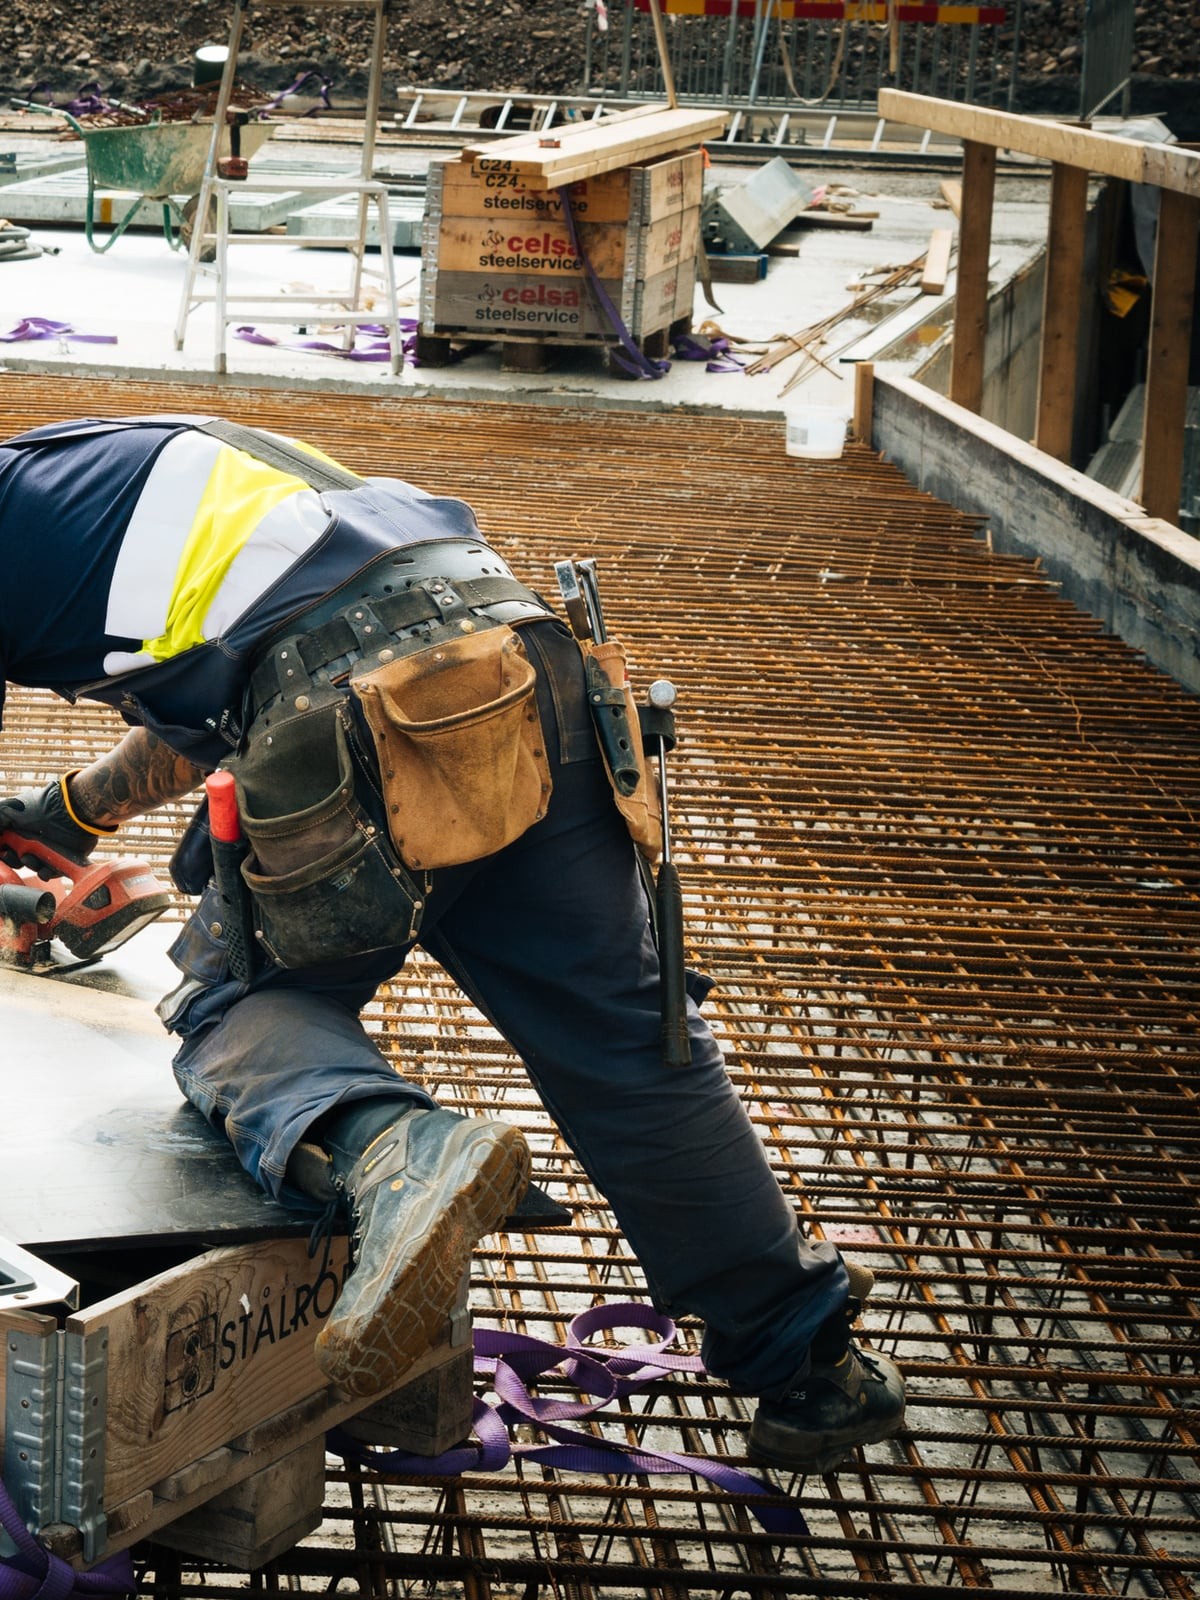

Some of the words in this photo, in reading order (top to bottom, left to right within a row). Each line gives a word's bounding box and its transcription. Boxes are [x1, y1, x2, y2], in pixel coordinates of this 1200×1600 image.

[484, 195, 588, 212] steelservce
[479, 253, 583, 270] steelservice
[502, 284, 578, 307] celsa
[475, 307, 579, 323] steelservice
